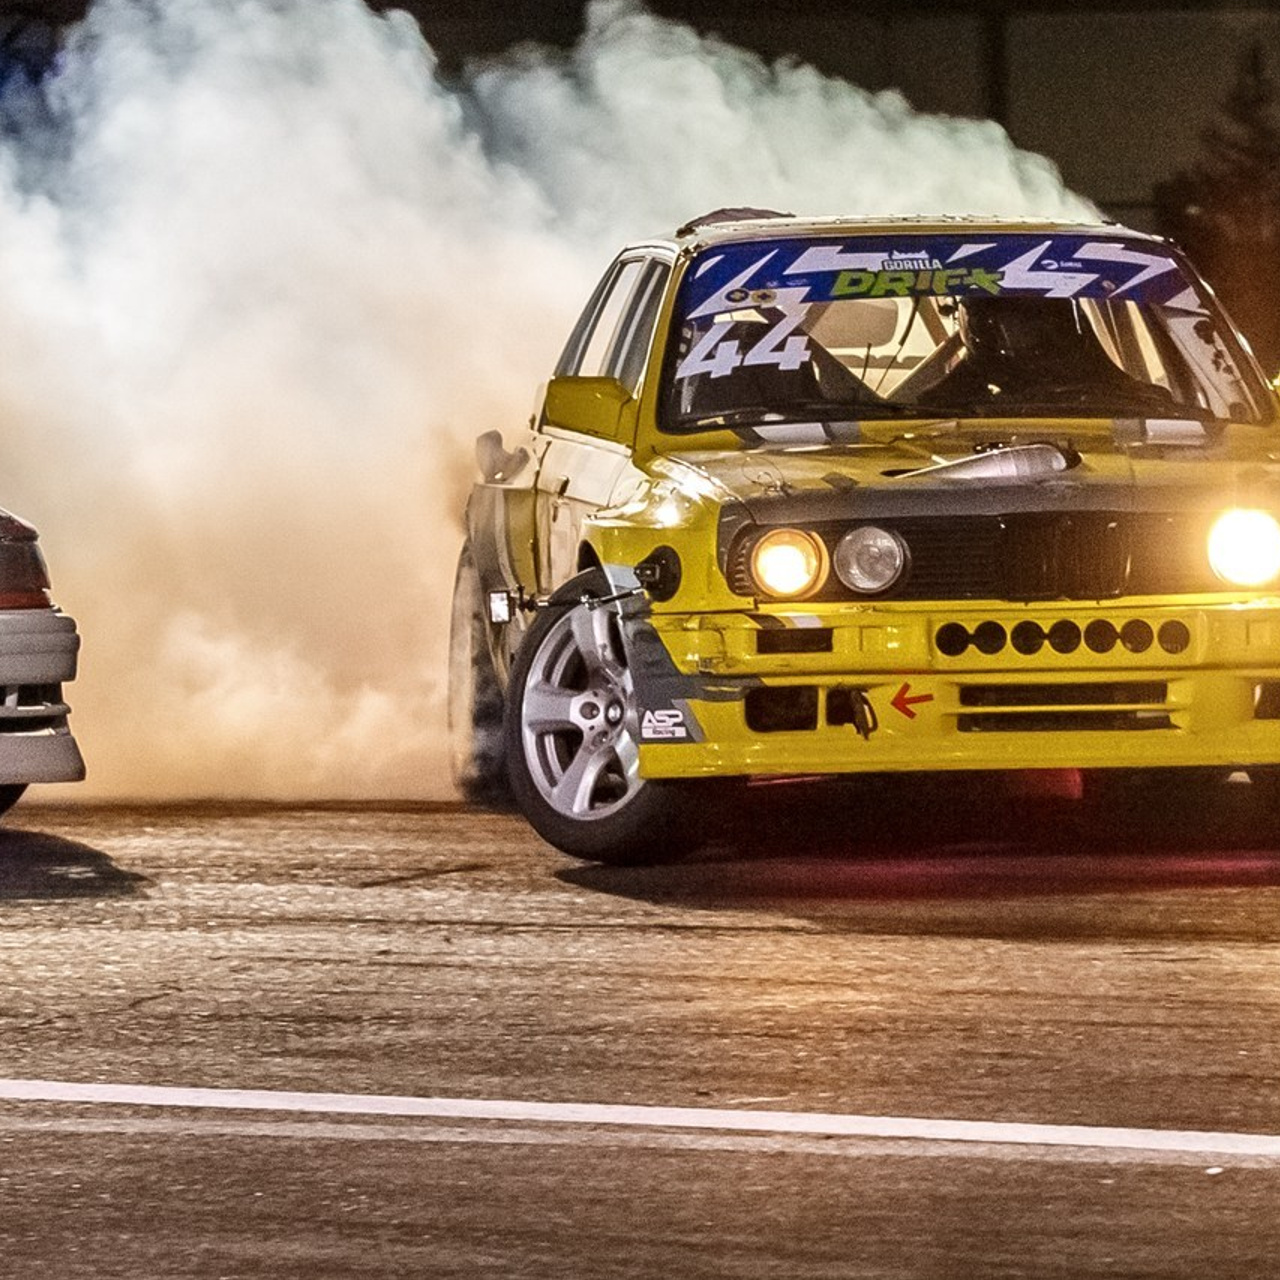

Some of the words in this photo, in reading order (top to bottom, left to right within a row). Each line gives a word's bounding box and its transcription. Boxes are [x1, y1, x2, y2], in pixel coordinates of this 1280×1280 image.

[883, 258, 943, 271] GORILLA
[830, 268, 1004, 296] DRIFT
[675, 302, 812, 379] 44
[641, 709, 684, 727] ASP
